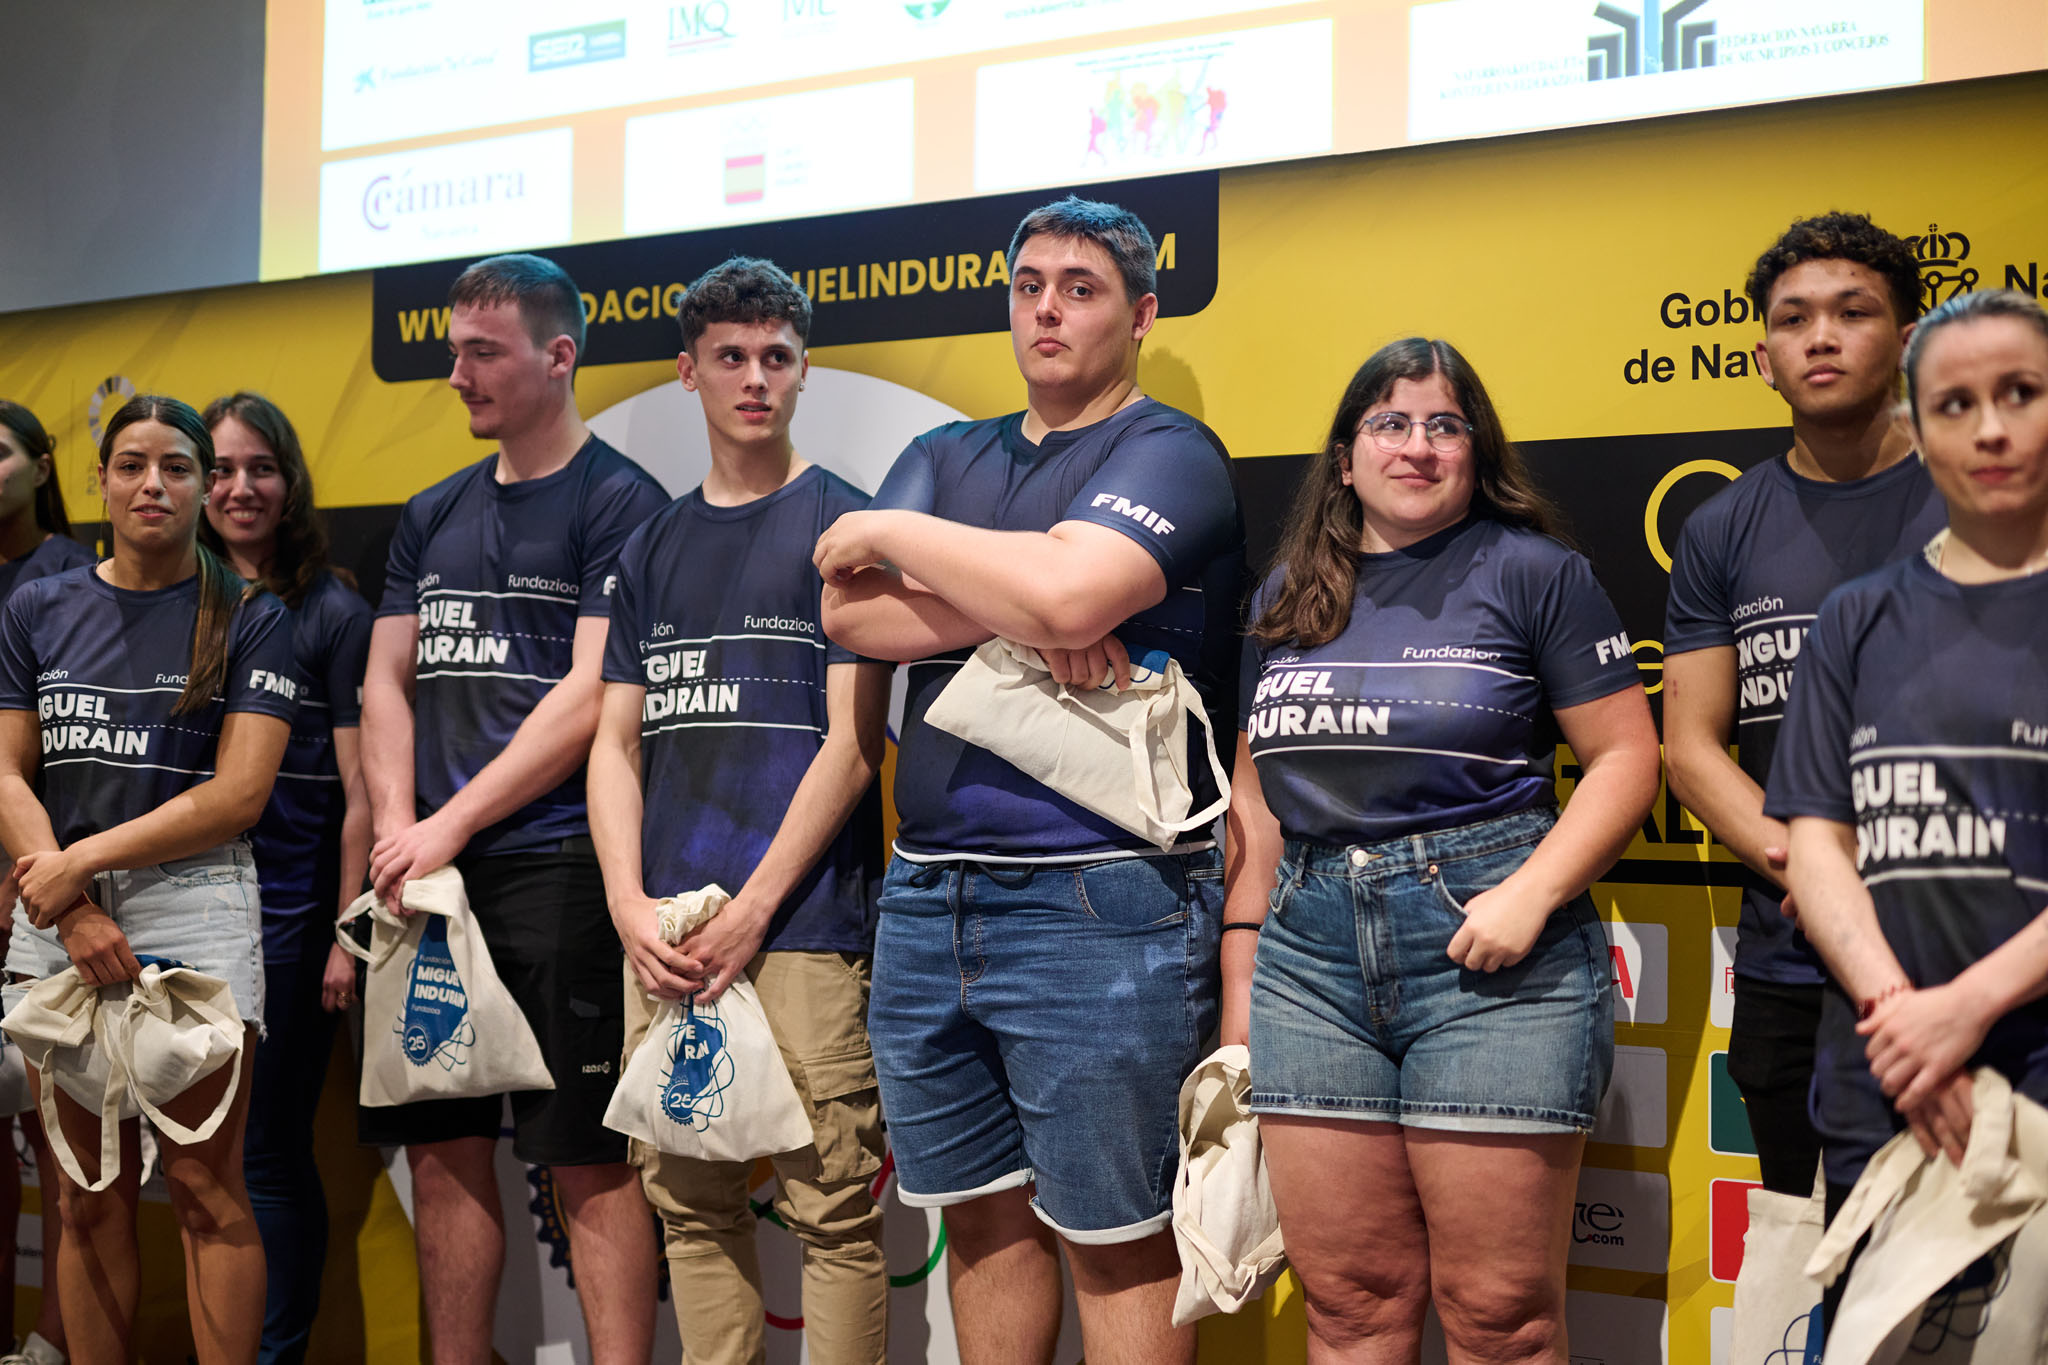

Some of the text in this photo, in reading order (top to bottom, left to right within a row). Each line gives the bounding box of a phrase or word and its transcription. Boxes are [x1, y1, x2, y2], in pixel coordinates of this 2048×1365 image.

[1623, 348, 1676, 385] de
[1091, 492, 1176, 535] FMIF
[407, 1035, 426, 1052] 25
